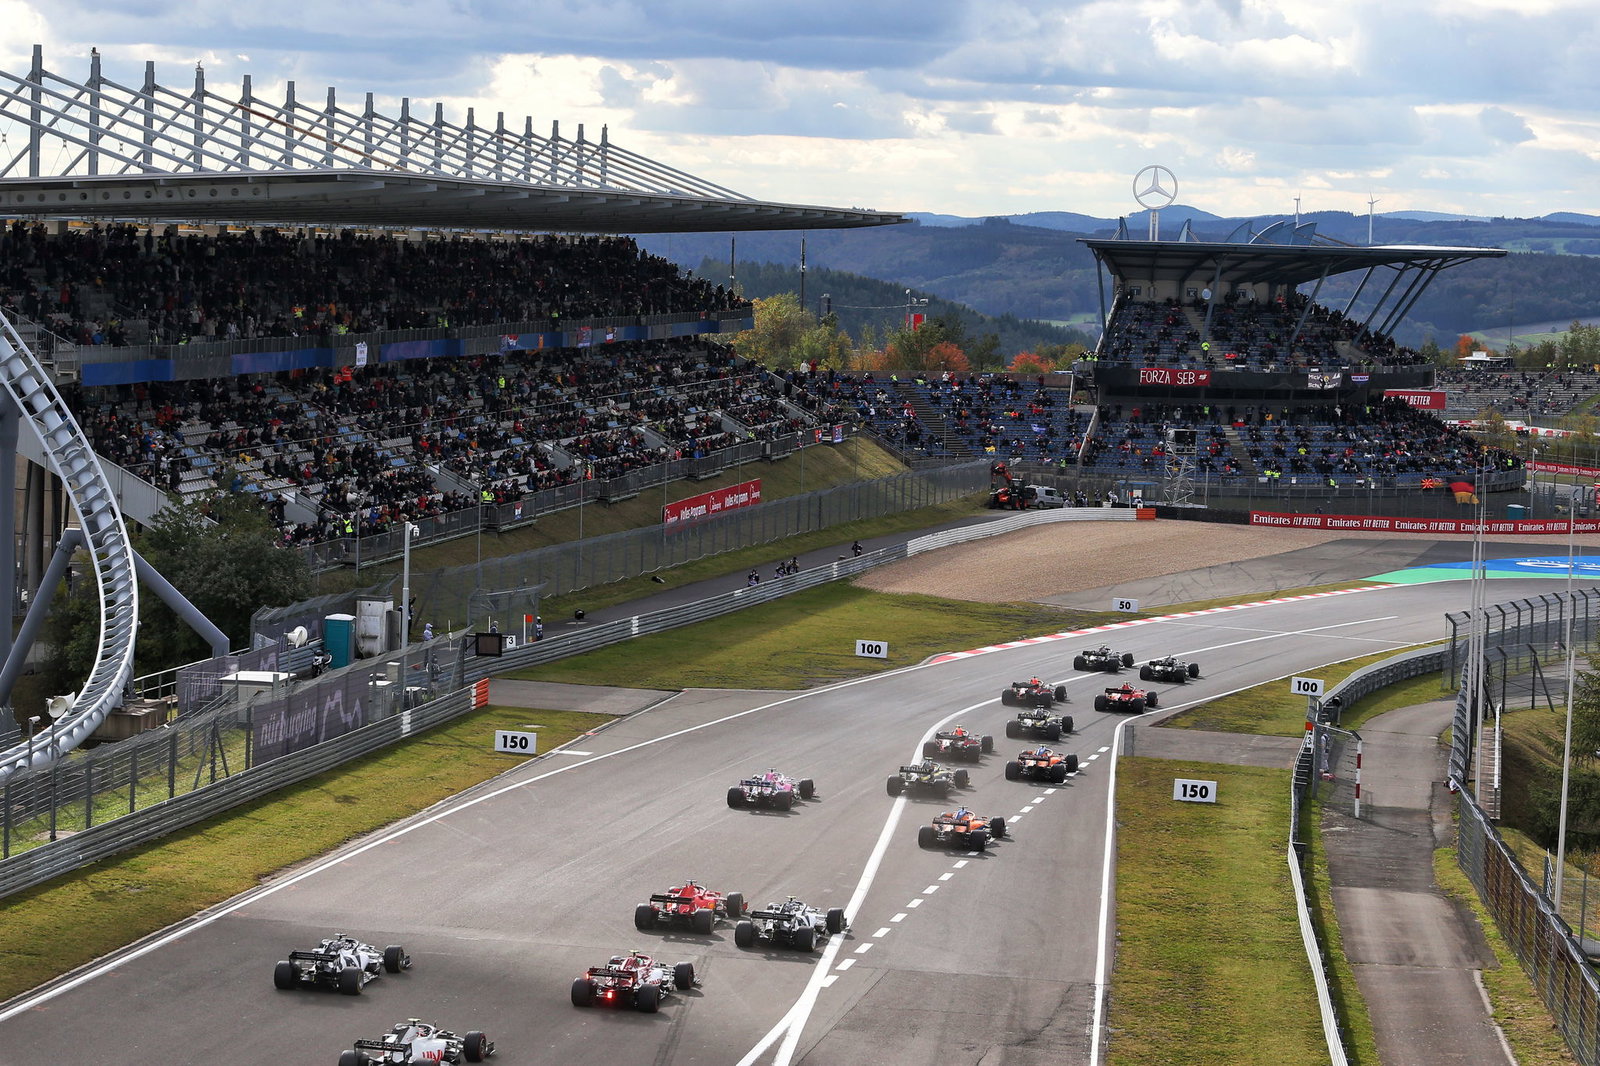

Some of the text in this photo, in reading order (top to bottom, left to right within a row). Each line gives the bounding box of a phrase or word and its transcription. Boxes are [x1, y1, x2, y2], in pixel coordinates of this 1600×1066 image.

[1139, 370, 1196, 385] FORZA SEB
[1409, 395, 1431, 406] BETTER
[1253, 514, 1321, 526] Emirates FLY BETTER
[1327, 518, 1390, 528] Emirates FLY BETTER
[1395, 520, 1456, 531] Emirates FLY BETTER
[1491, 523, 1500, 531] FLY
[1500, 523, 1514, 532] BETTER
[1518, 522, 1568, 532] Emirates FLY BETTER
[1119, 600, 1131, 610] 50
[508, 636, 514, 645] 3
[861, 643, 882, 655] 100
[1297, 680, 1318, 693] 100
[260, 701, 317, 746] nürburgring
[502, 735, 529, 749] 150
[1307, 736, 1312, 745] 3
[1181, 784, 1209, 798] 150
